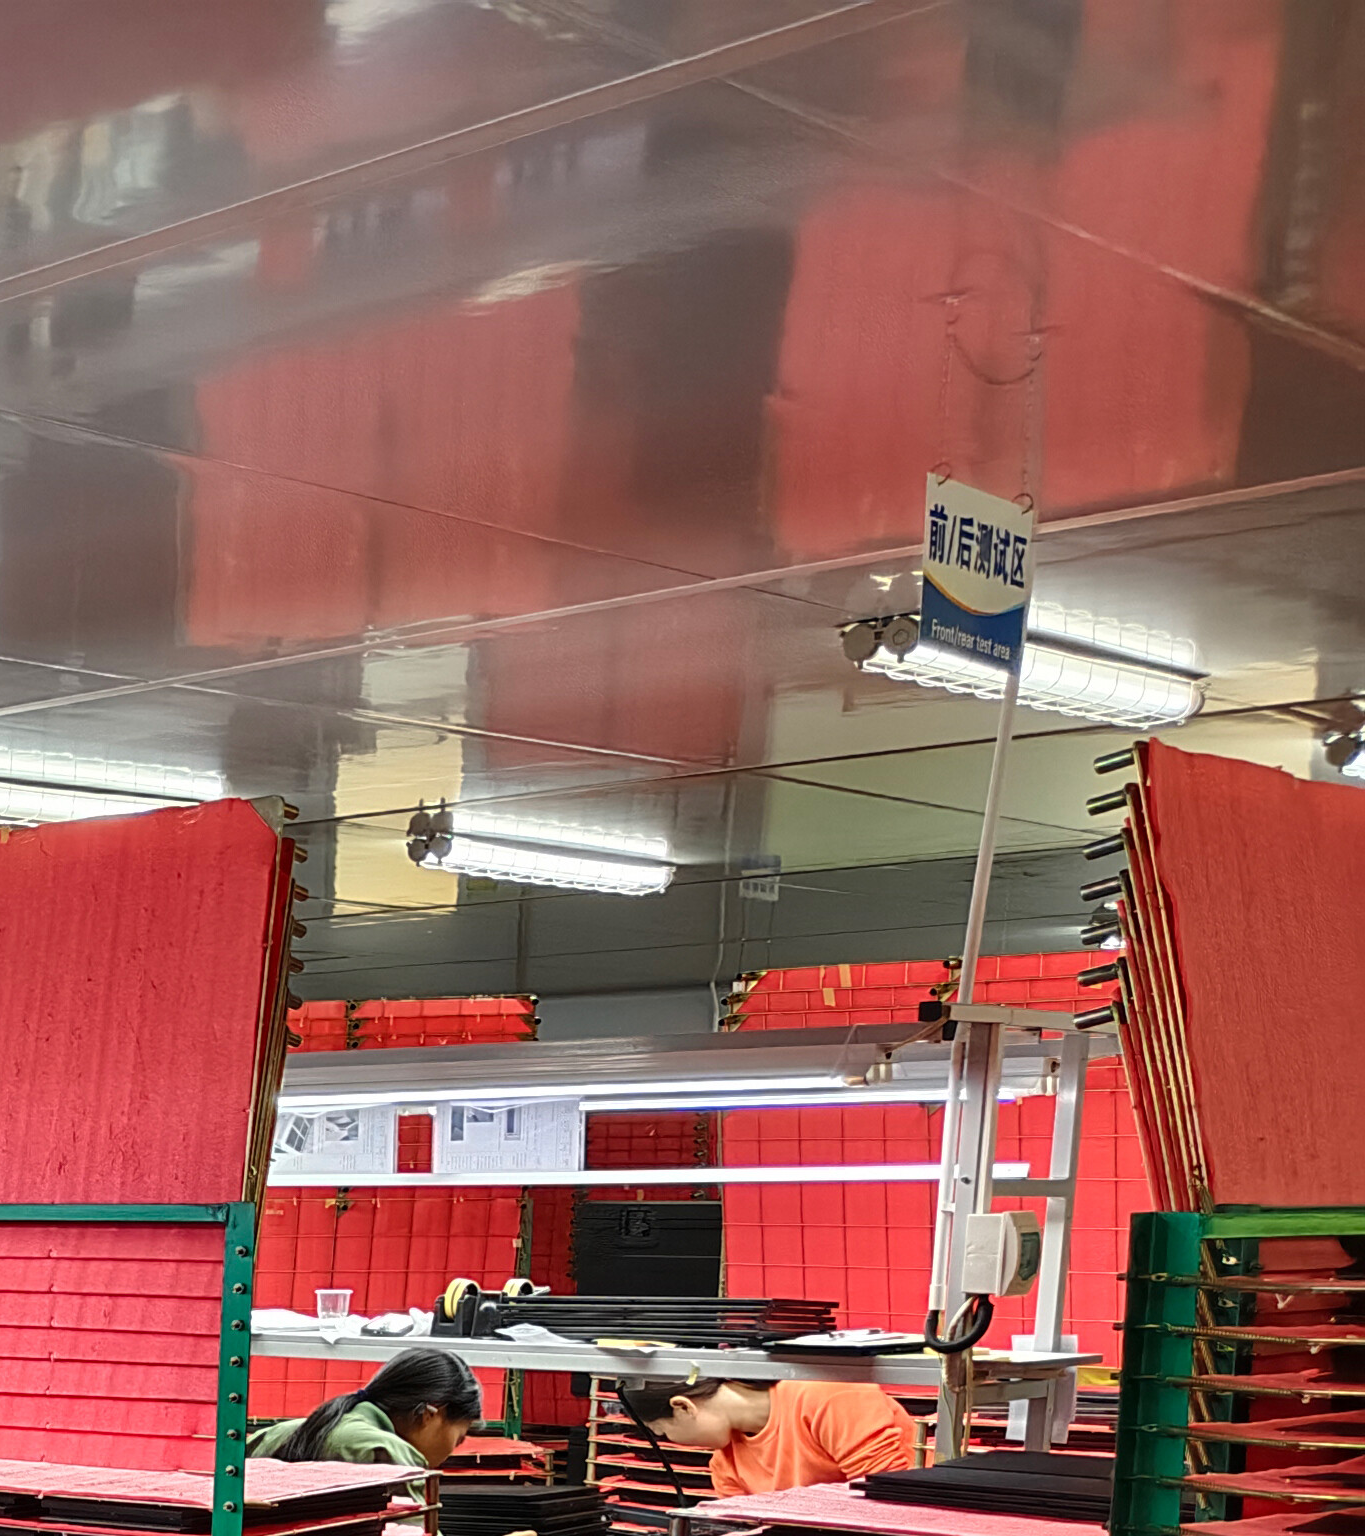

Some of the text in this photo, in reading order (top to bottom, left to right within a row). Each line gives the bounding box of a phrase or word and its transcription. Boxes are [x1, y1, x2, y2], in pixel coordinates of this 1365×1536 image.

[929, 503, 1027, 588] 前/后测试区
[931, 618, 1011, 660] Front/rear test area
